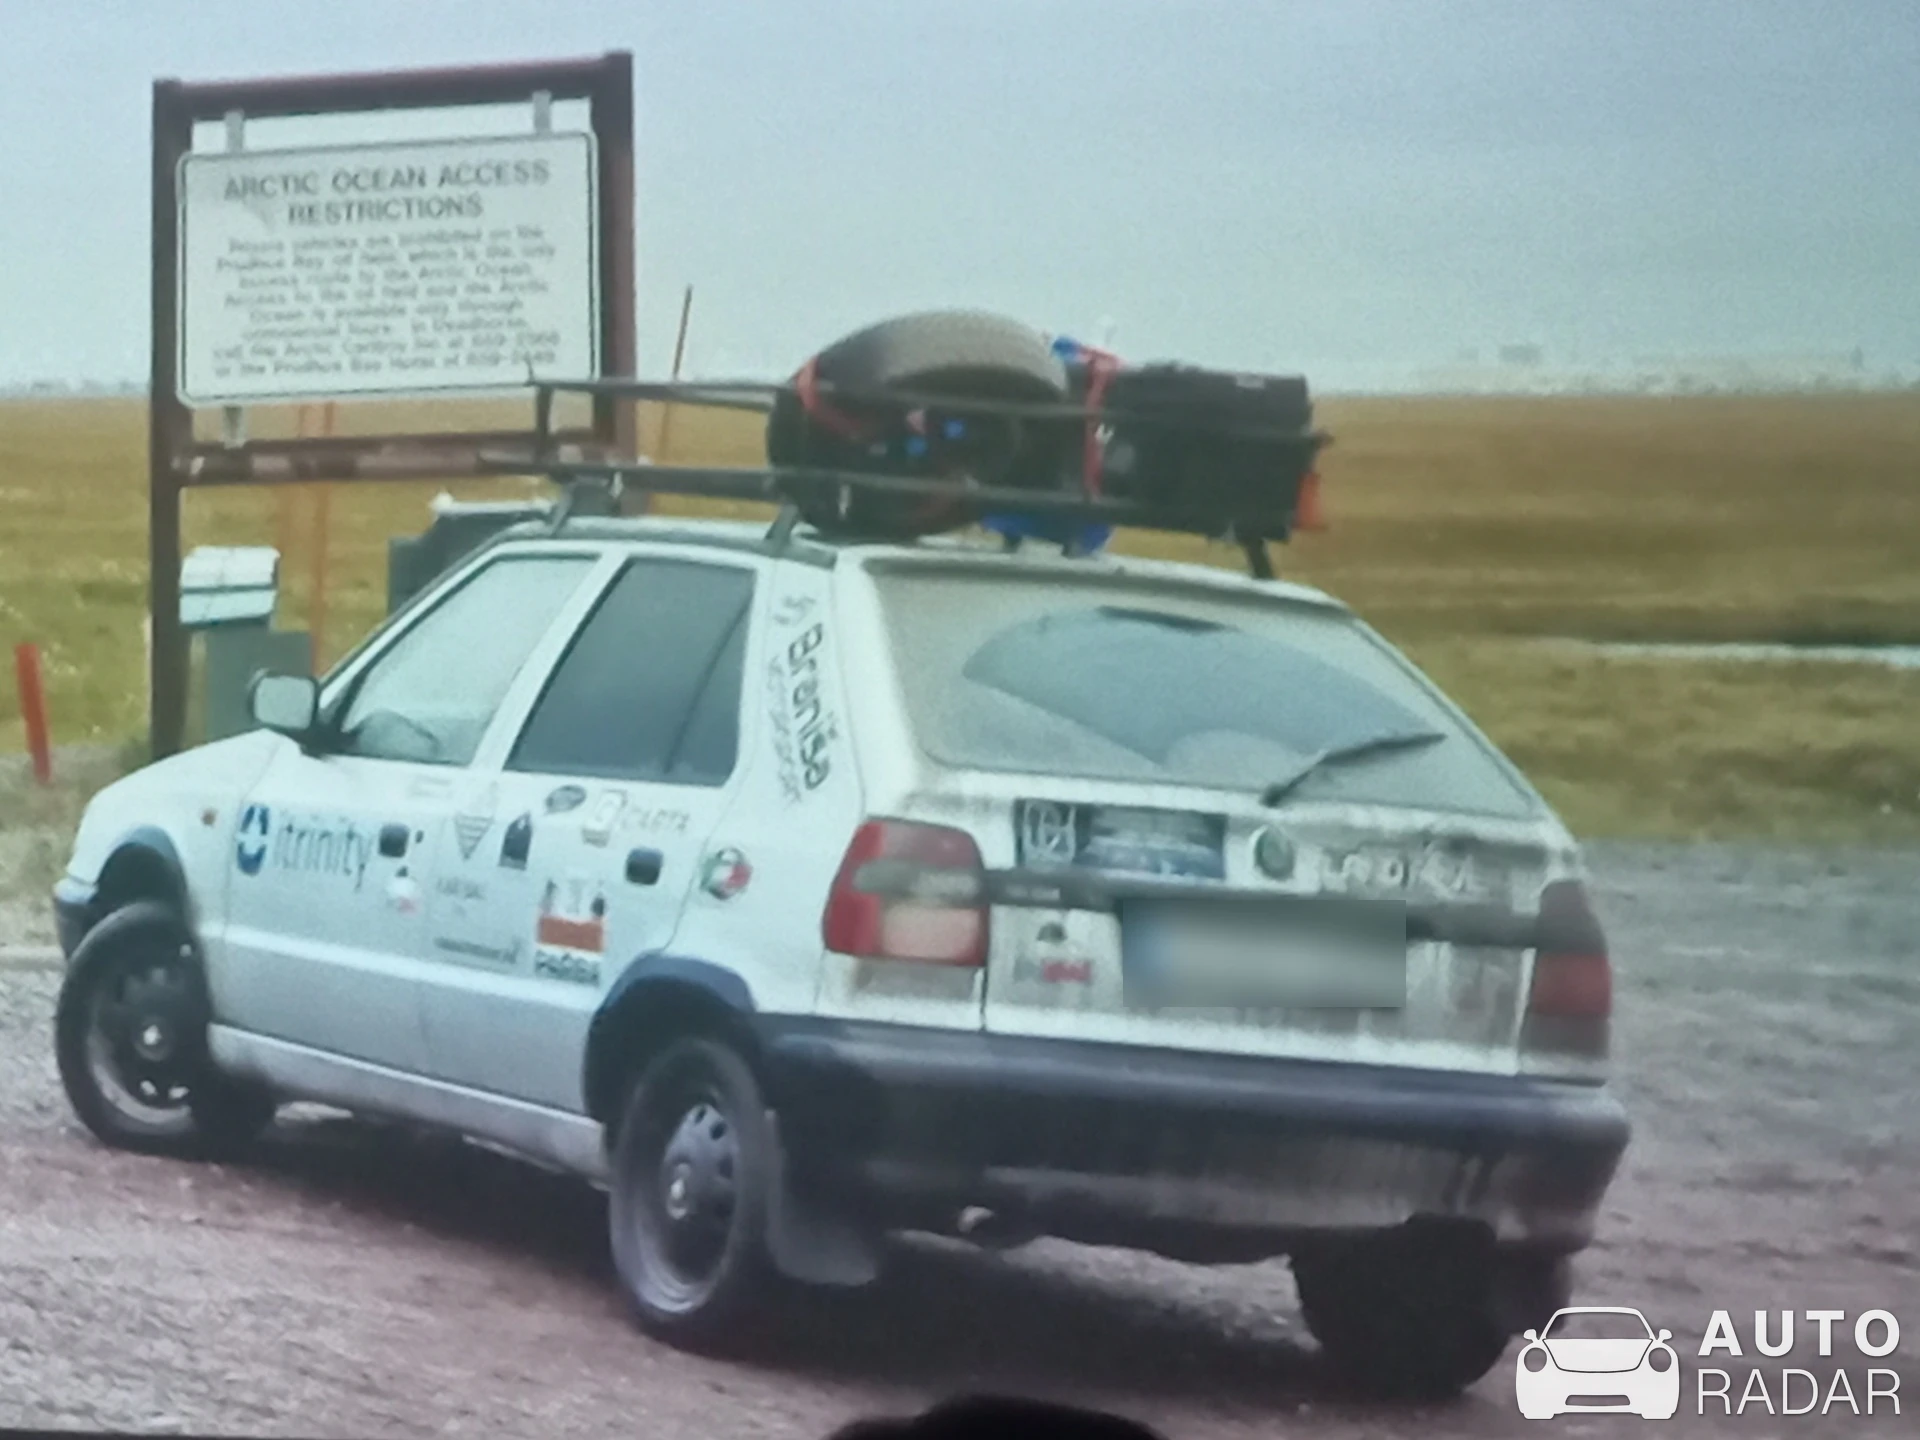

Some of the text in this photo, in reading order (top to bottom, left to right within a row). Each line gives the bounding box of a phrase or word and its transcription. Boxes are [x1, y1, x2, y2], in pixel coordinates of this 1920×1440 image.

[225, 159, 550, 200] ARCTIC OCEAN ACCESS
[288, 193, 483, 226] RESTRICTIONS
